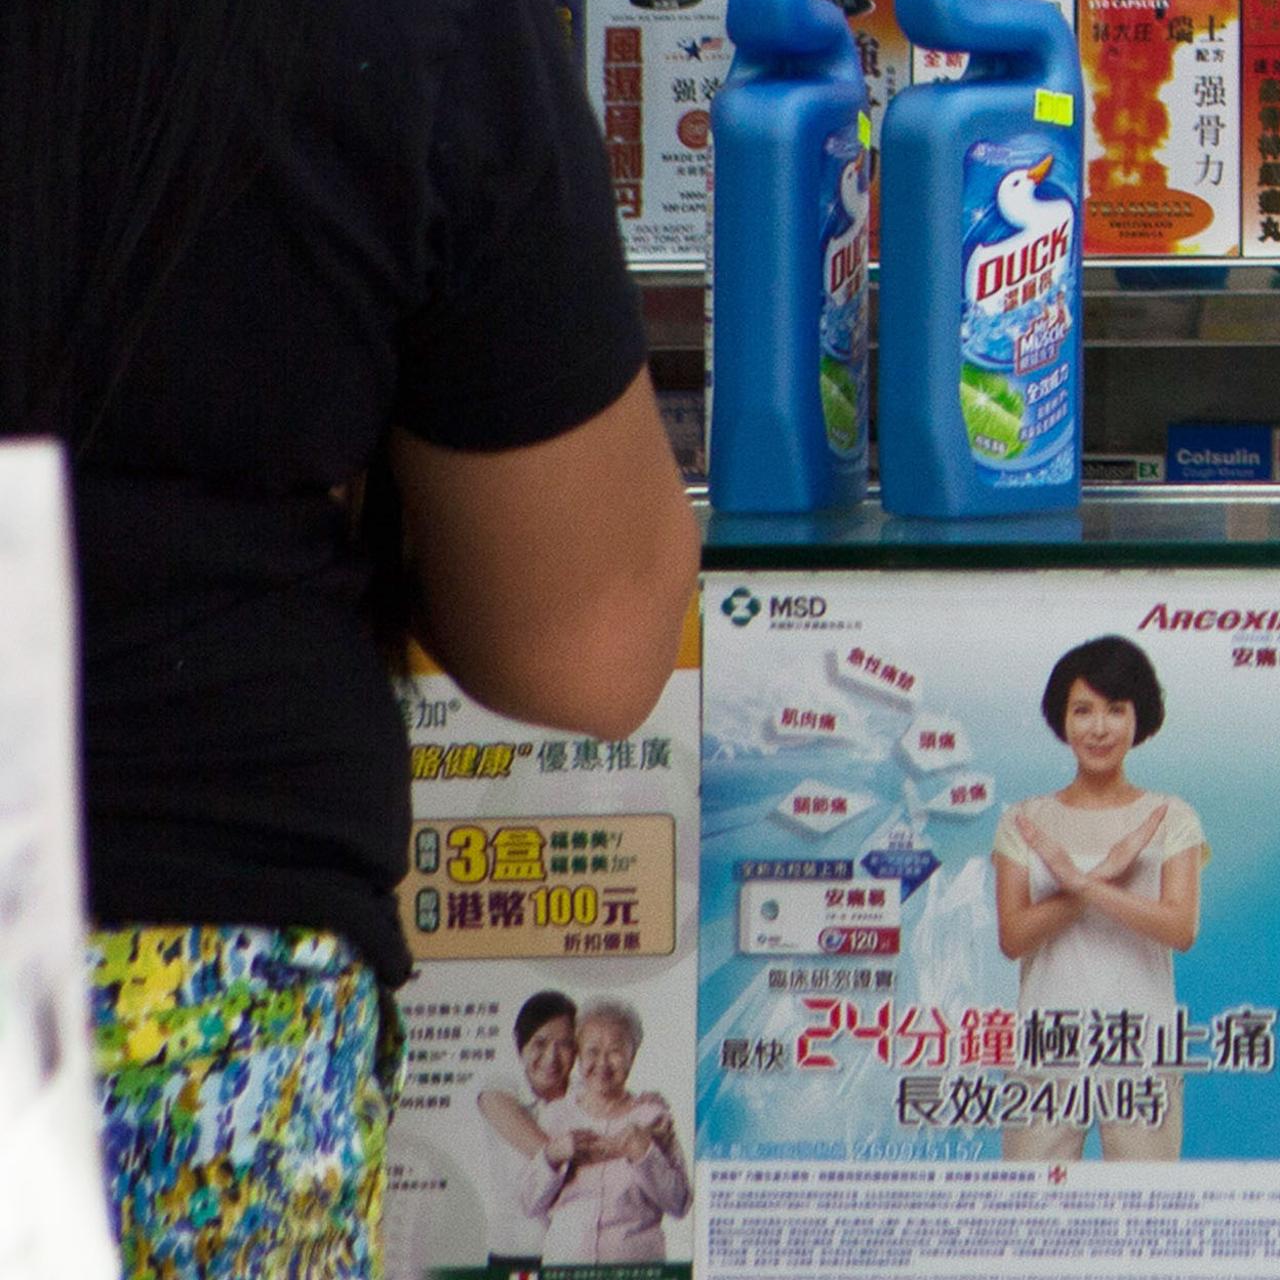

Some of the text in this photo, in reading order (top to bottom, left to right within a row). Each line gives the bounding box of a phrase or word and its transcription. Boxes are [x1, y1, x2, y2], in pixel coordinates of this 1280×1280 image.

[770, 596, 827, 618] MSD
[896, 1076, 1167, 1127] 長效24小時
